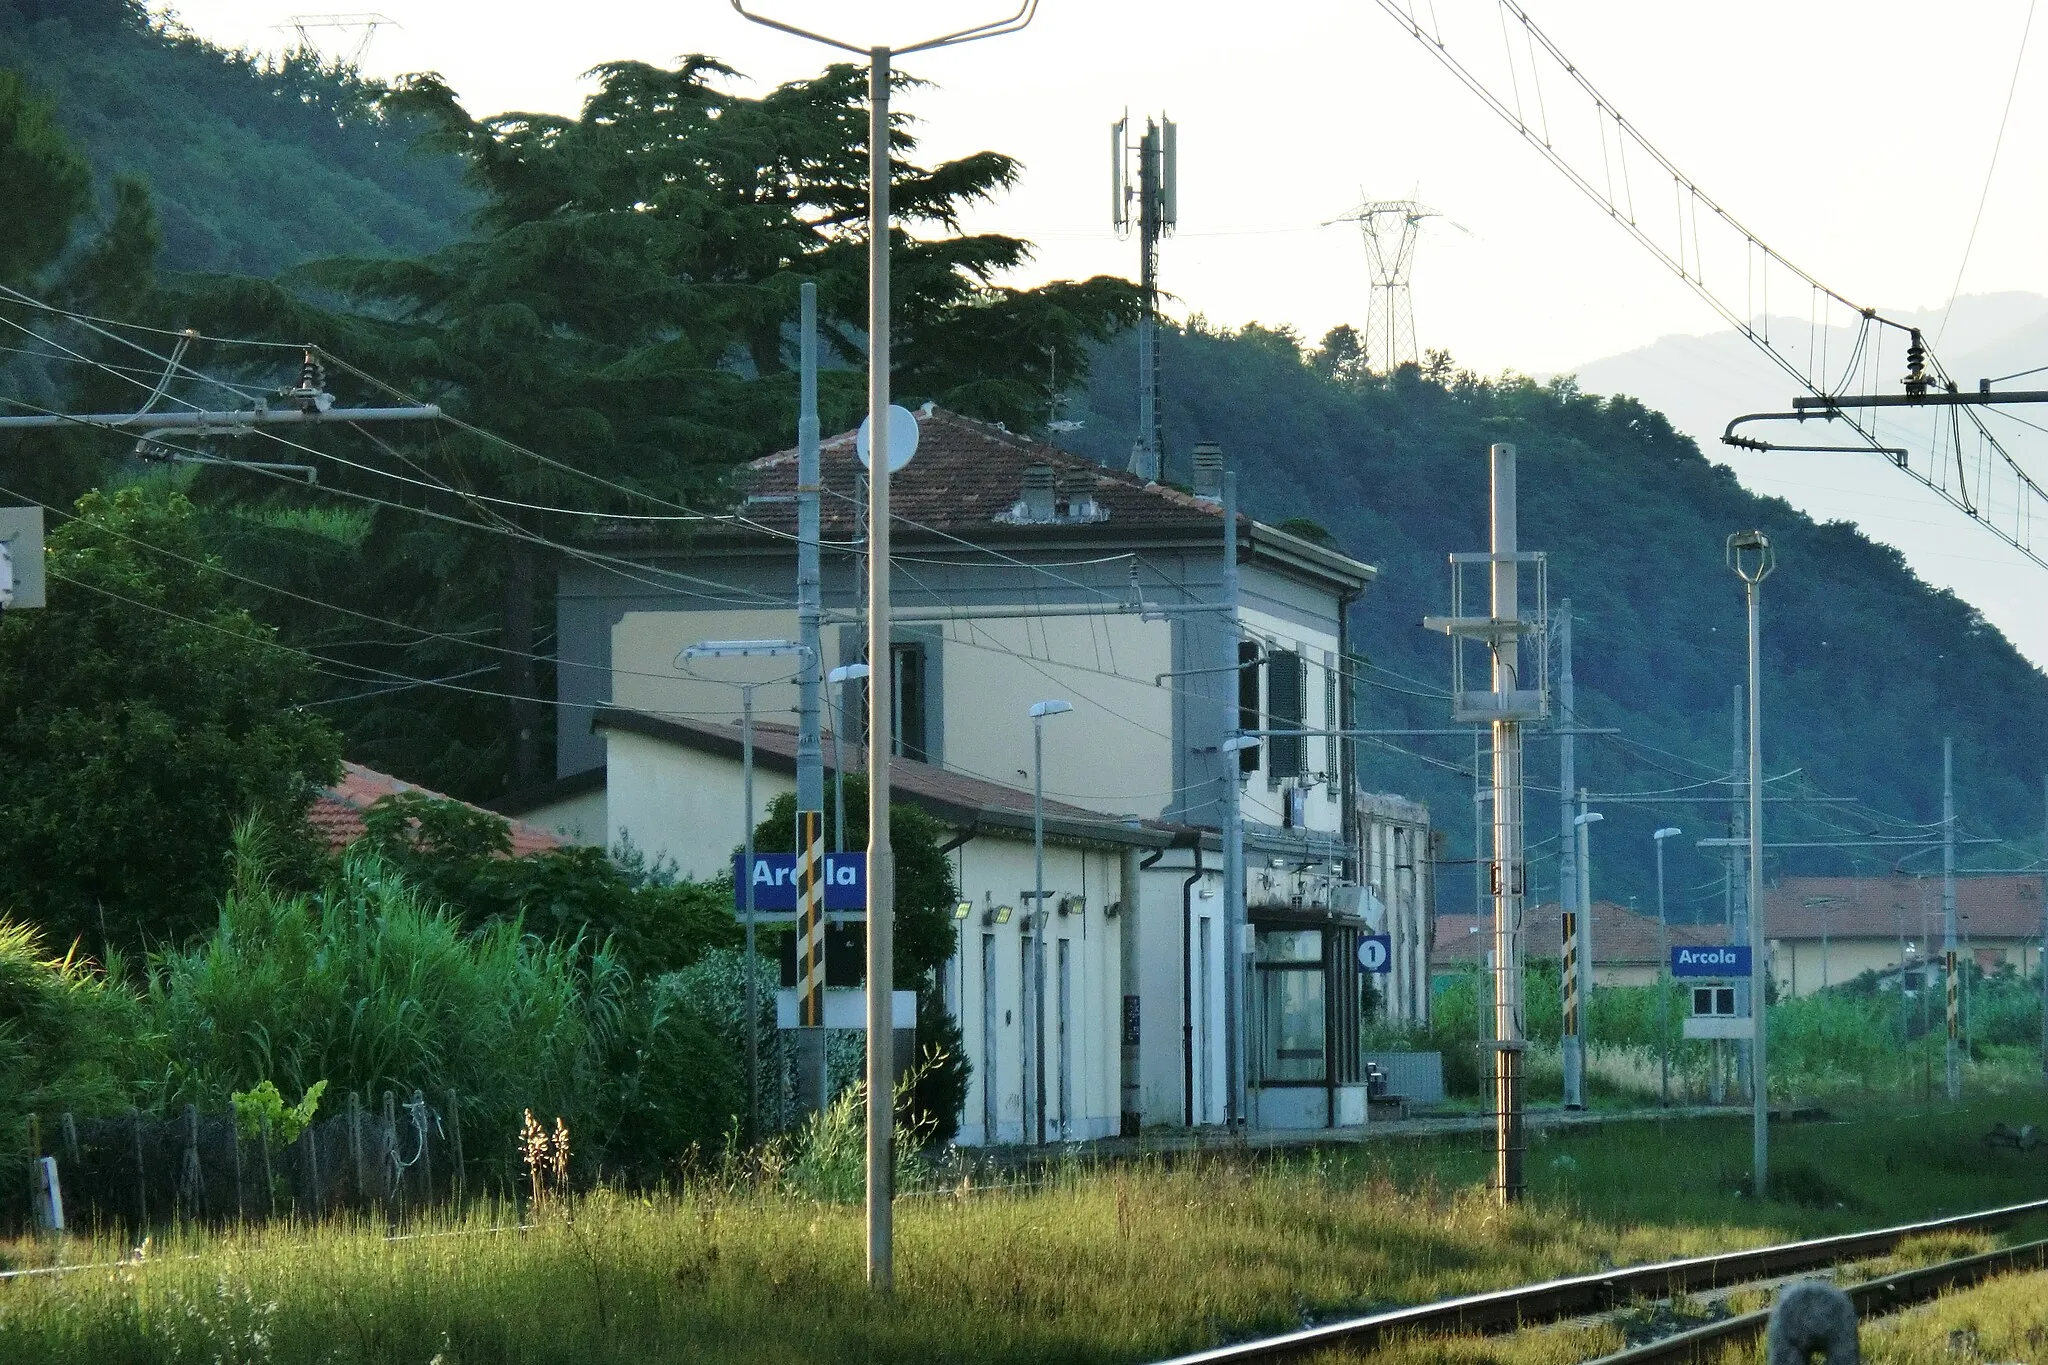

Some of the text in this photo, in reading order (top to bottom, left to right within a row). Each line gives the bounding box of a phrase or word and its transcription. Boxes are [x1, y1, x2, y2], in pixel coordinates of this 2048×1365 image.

[752, 859, 856, 886] Arla
[1368, 945, 1376, 962] 1
[1679, 949, 1736, 964] Arcola
